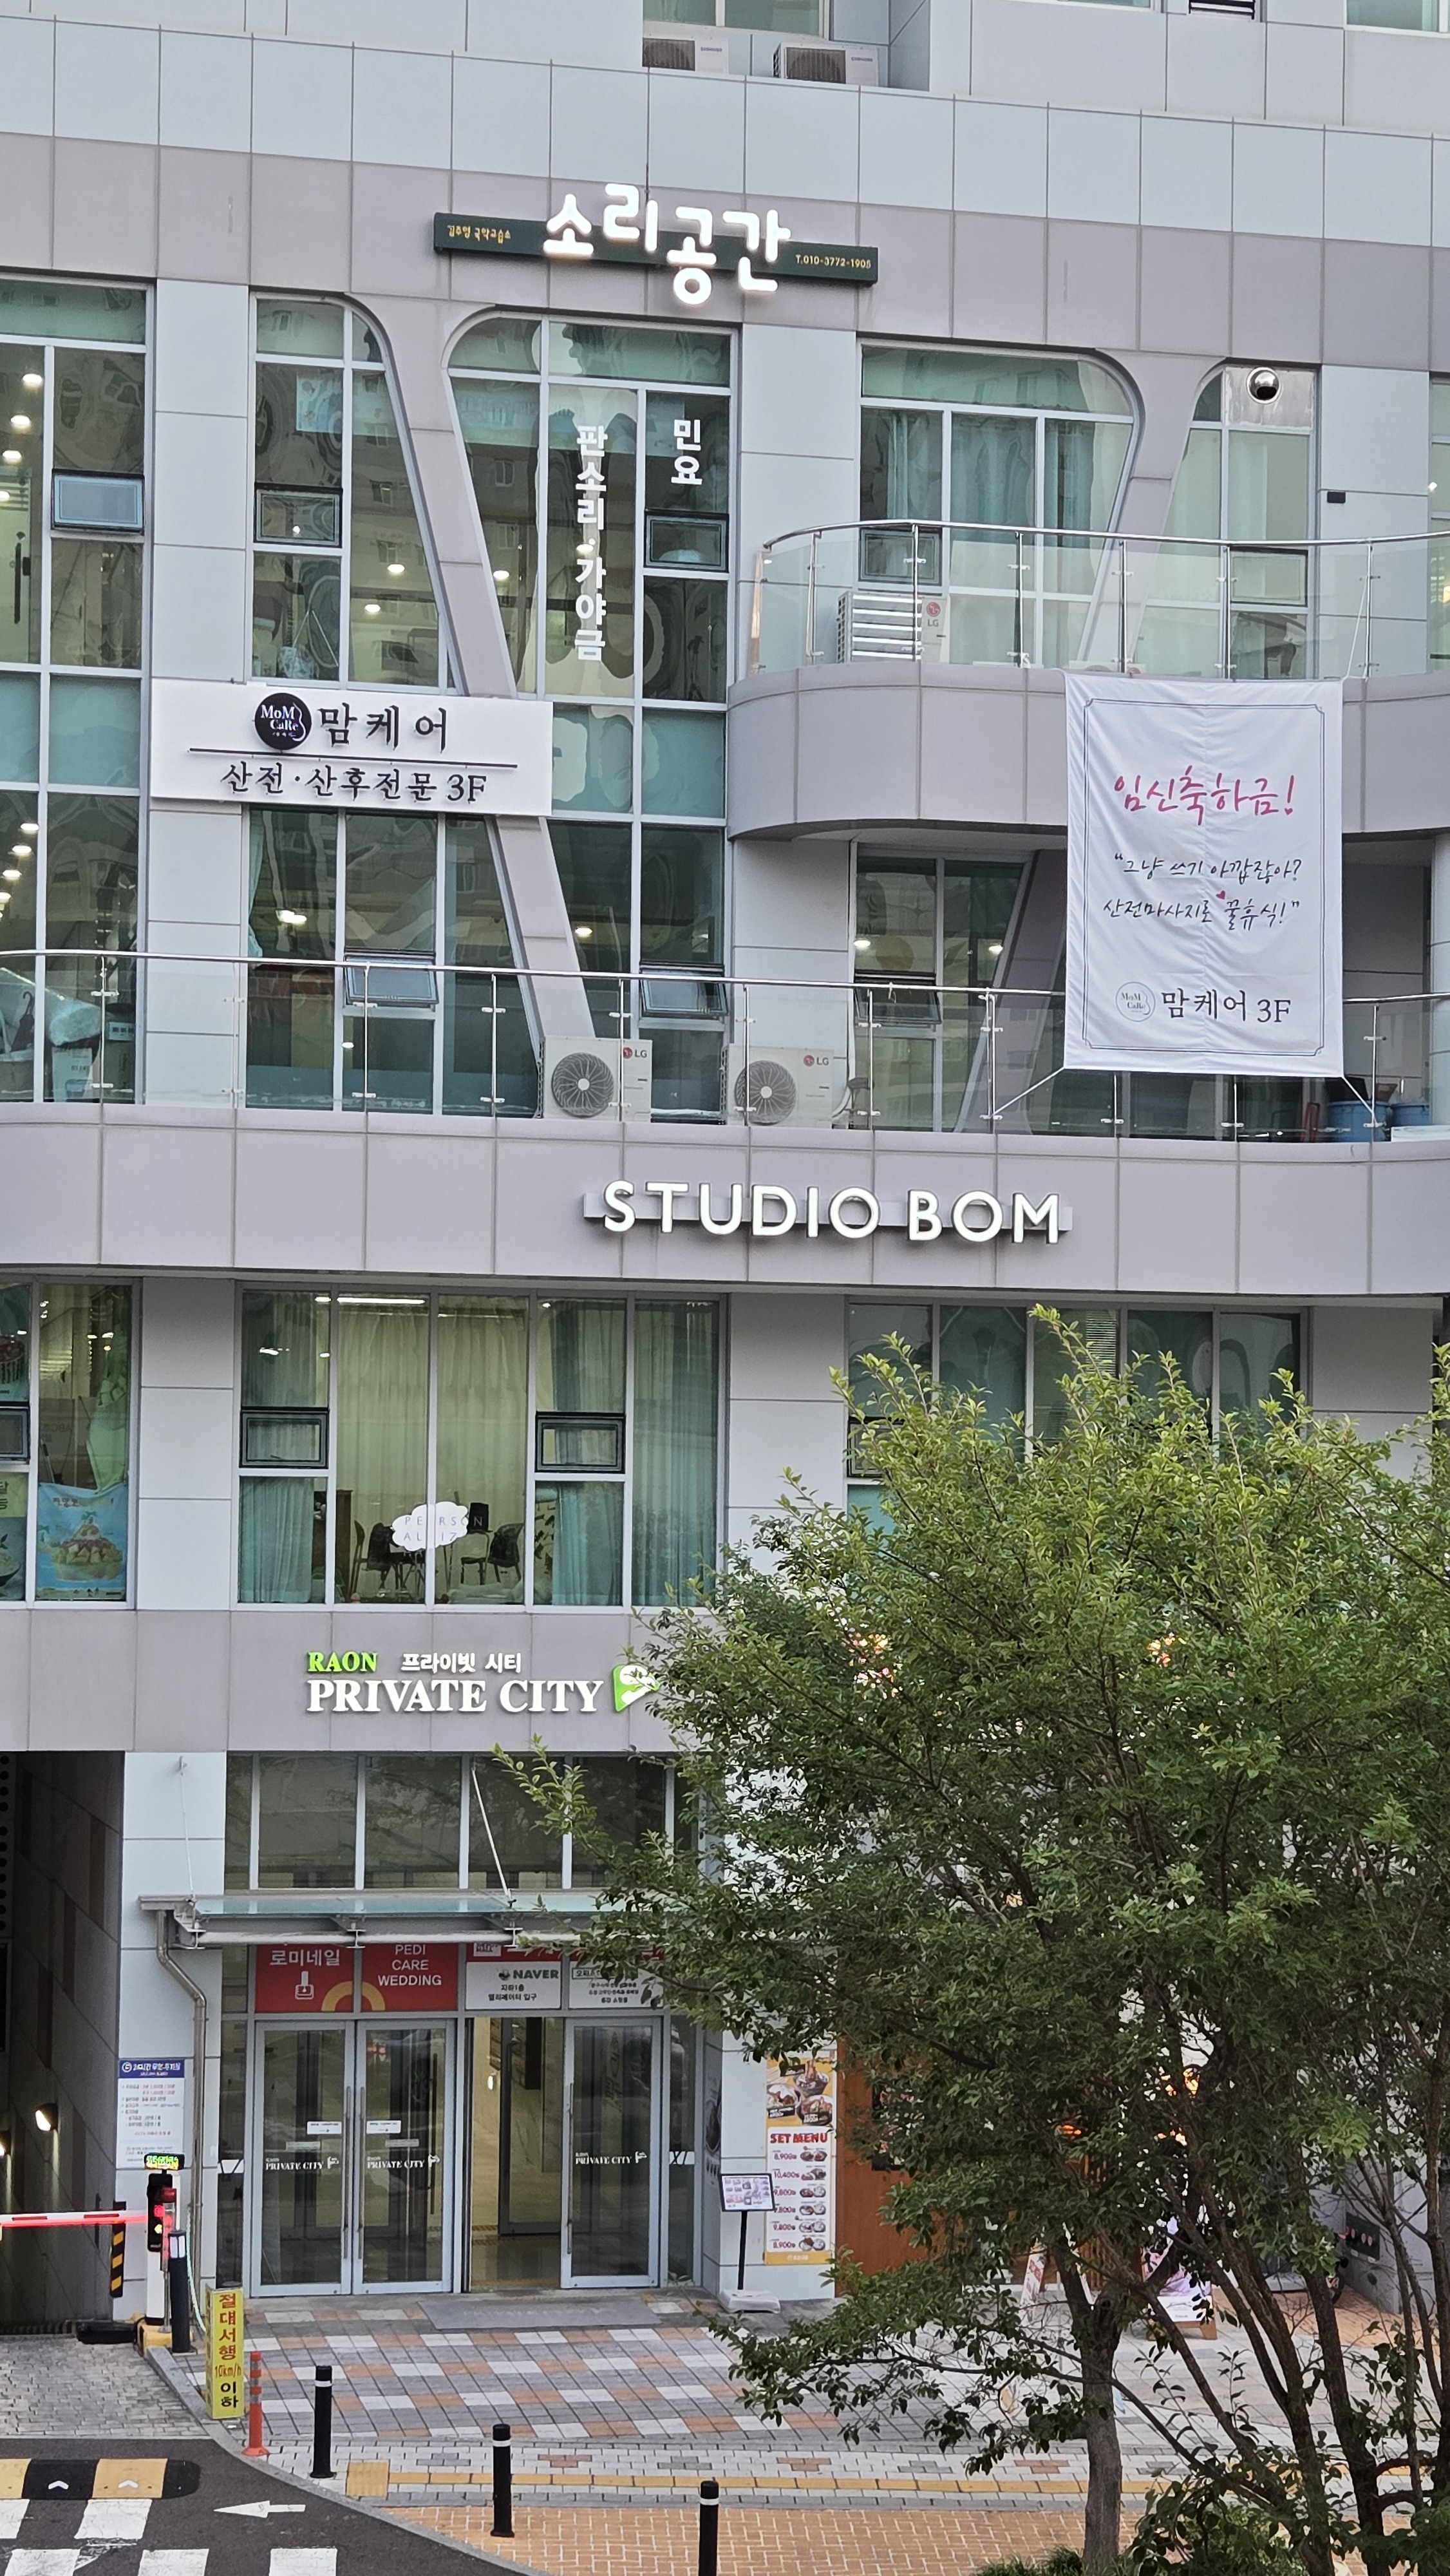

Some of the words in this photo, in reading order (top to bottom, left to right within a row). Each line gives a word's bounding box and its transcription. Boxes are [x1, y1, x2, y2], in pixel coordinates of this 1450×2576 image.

[543, 183, 791, 305] 소리공간
[671, 419, 703, 486] 민요
[927, 618, 939, 627] LG
[317, 702, 447, 753] 맘케어
[446, 773, 487, 804] 3F
[1114, 764, 1295, 826] 임신축하금!
[1169, 860, 1203, 876] 쓰기
[1210, 858, 1302, 885] 아깝잖아?
[1103, 898, 1213, 923] 산전마사지로
[1162, 988, 1247, 1022] 맘케어
[1256, 998, 1292, 1023] 3F
[634, 1048, 648, 1058] LG
[816, 1056, 829, 1066] LG
[603, 1180, 881, 1240] STUDIO
[907, 1189, 1060, 1244] BOM
[308, 1651, 379, 1673] RAON
[400, 1652, 476, 1674] 프라이빗
[485, 1653, 522, 1674] 시티
[306, 1679, 487, 1713] PRIVATE
[499, 1680, 605, 1713] CITY
[269, 1949, 341, 1966] 로미네일
[395, 1944, 426, 1956] PEDI
[391, 1959, 429, 1971] CARE
[513, 1969, 560, 1980] NAVER
[377, 1975, 442, 1987] WEDDING
[770, 2133, 792, 2144] SET
[793, 2132, 828, 2143] MENU
[265, 2162, 301, 2171] PRIVATE
[367, 2161, 402, 2169] PRIVATE
[218, 2293, 236, 2361] 절대서행
[214, 2362, 242, 2378] 10km/h
[220, 2381, 239, 2409] 이하
